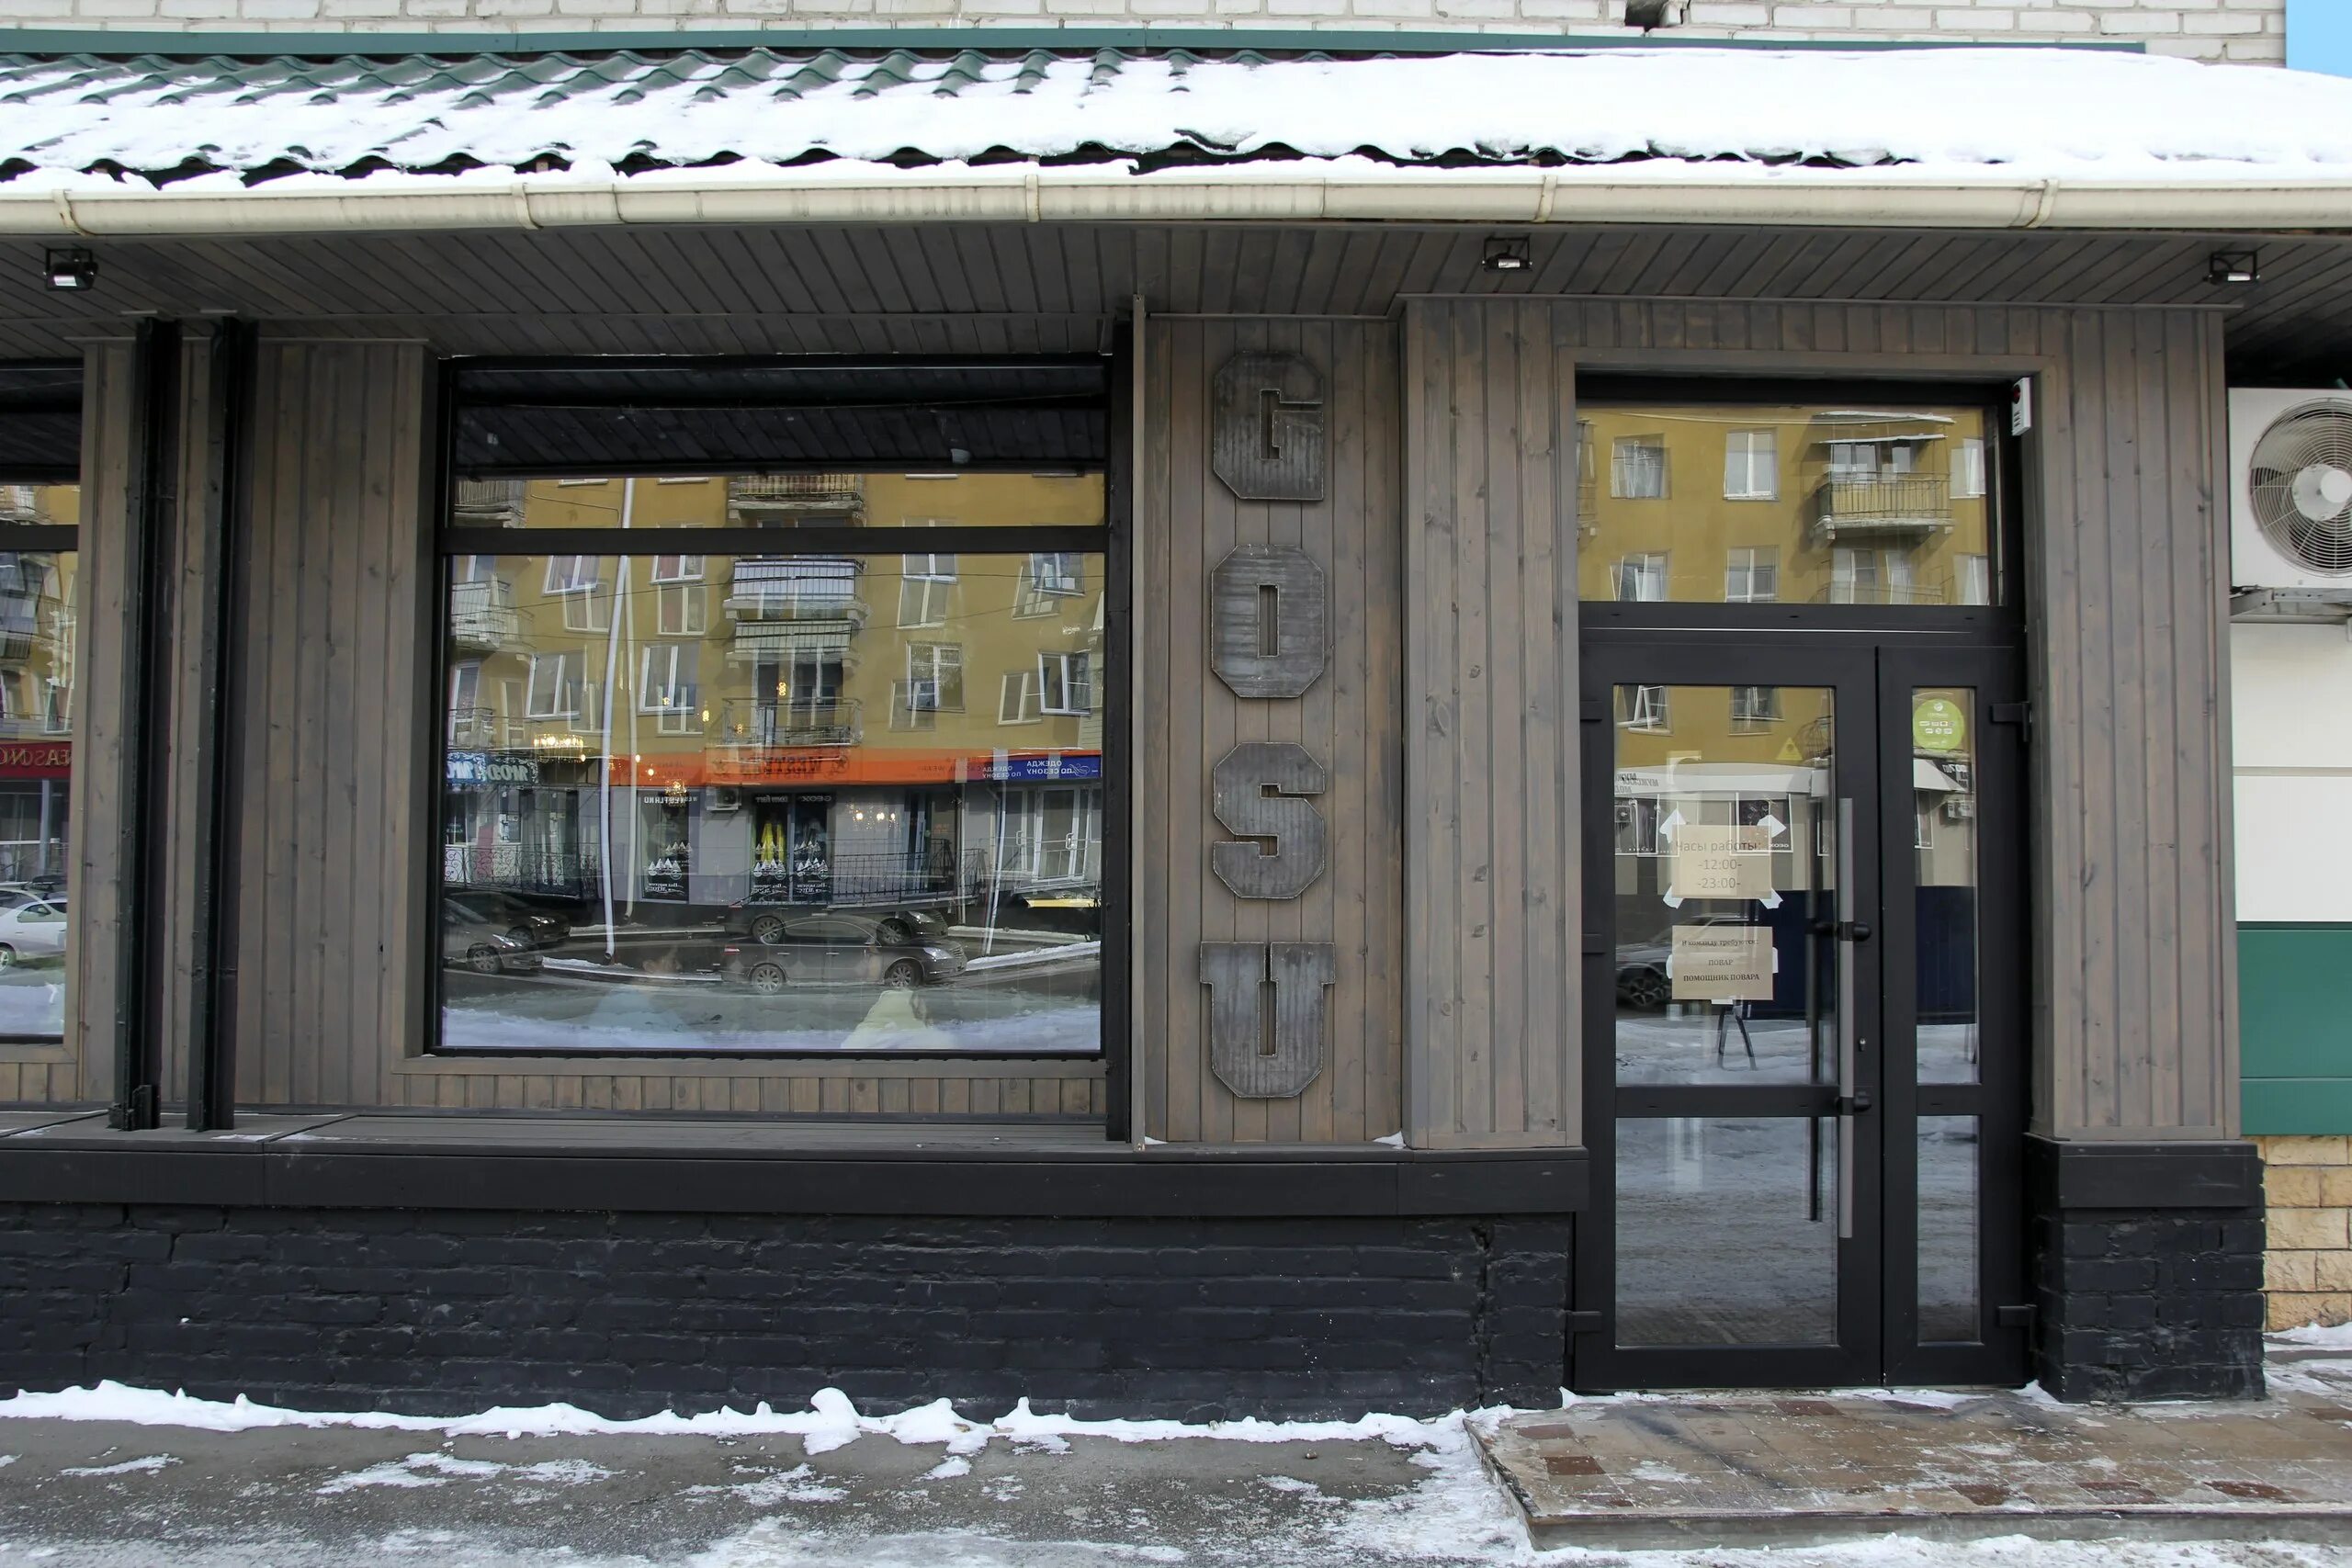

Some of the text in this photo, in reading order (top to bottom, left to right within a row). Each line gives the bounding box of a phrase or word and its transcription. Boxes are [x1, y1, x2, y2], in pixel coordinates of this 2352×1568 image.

[1199, 349, 1336, 1100] GOSU
[1675, 839, 1761, 854] Часы работы:
[1698, 859, 1743, 870] -12:00-
[1698, 877, 1742, 889] -23:00-
